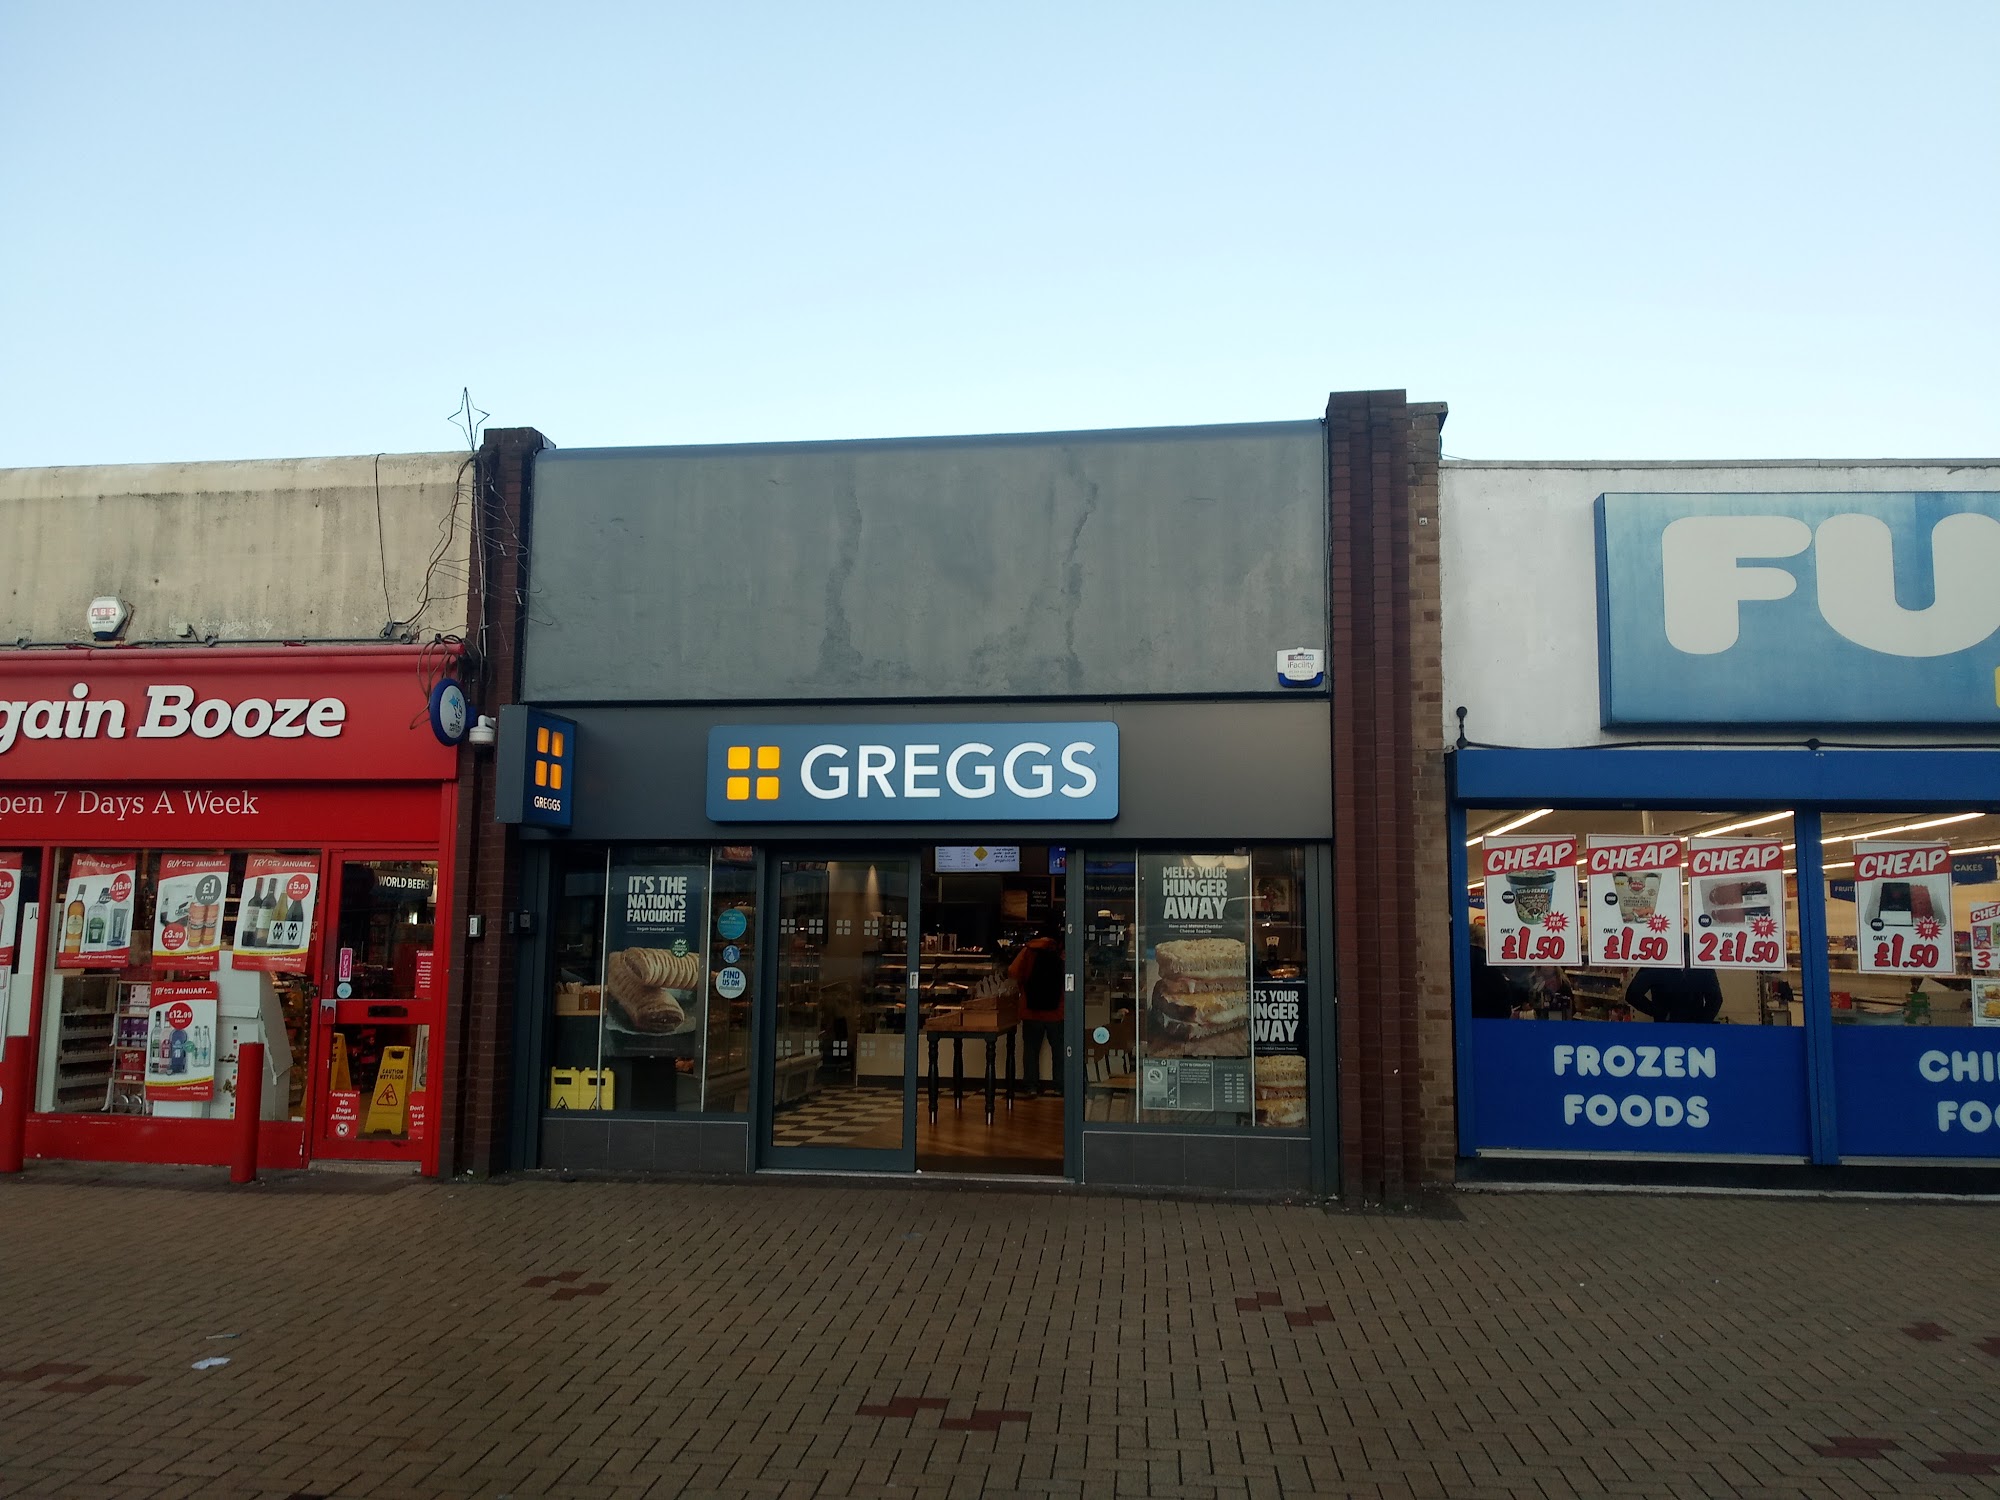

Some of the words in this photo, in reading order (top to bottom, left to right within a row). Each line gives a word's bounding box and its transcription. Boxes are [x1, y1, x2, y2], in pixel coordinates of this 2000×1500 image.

[1661, 512, 2000, 657] FU
[93, 608, 115, 616] ABS
[137, 685, 346, 739] Booze
[800, 741, 1098, 800] GREGGS
[54, 791, 69, 814] 7
[78, 791, 145, 821] Days
[152, 791, 175, 814] A
[184, 791, 259, 815] Week
[534, 796, 561, 811] GREGGS
[253, 859, 268, 867] TRY
[1487, 843, 1573, 872] CHEAP
[1591, 843, 1678, 871] CHEAP
[1693, 846, 1780, 873] CHEAP
[1859, 850, 1947, 878] CHEAP
[1163, 867, 1195, 879] MELTS
[1198, 867, 1228, 879] YOUR
[1954, 863, 1983, 872] CAKES
[203, 879, 216, 894] £1
[289, 881, 308, 890] £5.99
[379, 875, 407, 888] WORLD
[408, 878, 430, 890] BEERS
[628, 876, 655, 894] IT'S
[659, 876, 688, 894] THE
[1163, 880, 1228, 896] HUNGER
[1834, 885, 1855, 893] FRUIT
[627, 894, 686, 910] NATION'S
[1163, 897, 1228, 919] AWAY
[626, 910, 686, 923] FAVOURITE
[164, 930, 183, 939] £3.99
[1501, 926, 1565, 960] £1.50
[1604, 926, 1668, 960] £1.50
[1698, 932, 1718, 962] 2
[1720, 931, 1779, 963] £1.50
[1874, 933, 1939, 968] £1.50
[1975, 951, 1991, 968] 3
[723, 971, 740, 979] FIND
[1269, 991, 1299, 1002] YOUR
[169, 1010, 192, 1018] £12.99
[1553, 1045, 1716, 1078] FROZEN
[1919, 1049, 2000, 1082] CHI
[1563, 1094, 1710, 1128] FOODS
[1937, 1100, 2000, 1133] FO
